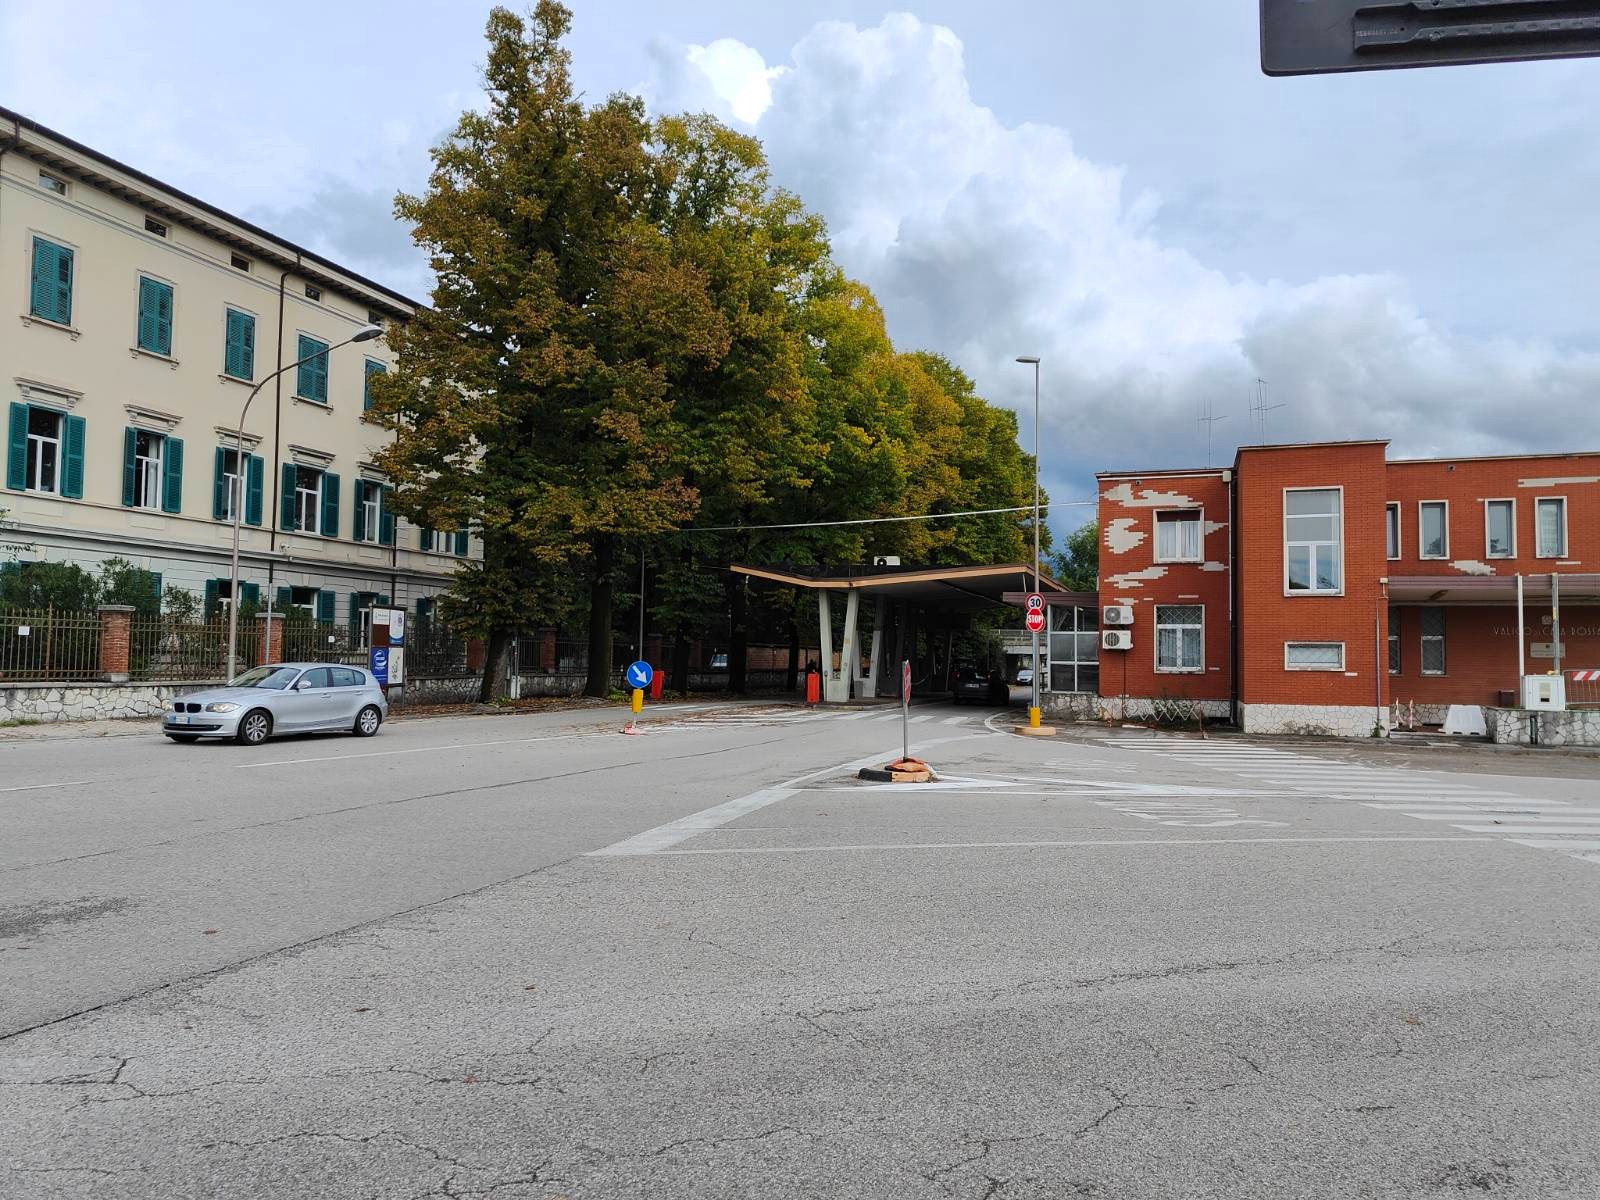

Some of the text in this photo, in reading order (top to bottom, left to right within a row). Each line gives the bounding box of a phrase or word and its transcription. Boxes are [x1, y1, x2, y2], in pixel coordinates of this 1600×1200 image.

[1030, 598, 1041, 608] 30
[1028, 614, 1043, 624] STOP
[1542, 625, 1566, 636] CA
